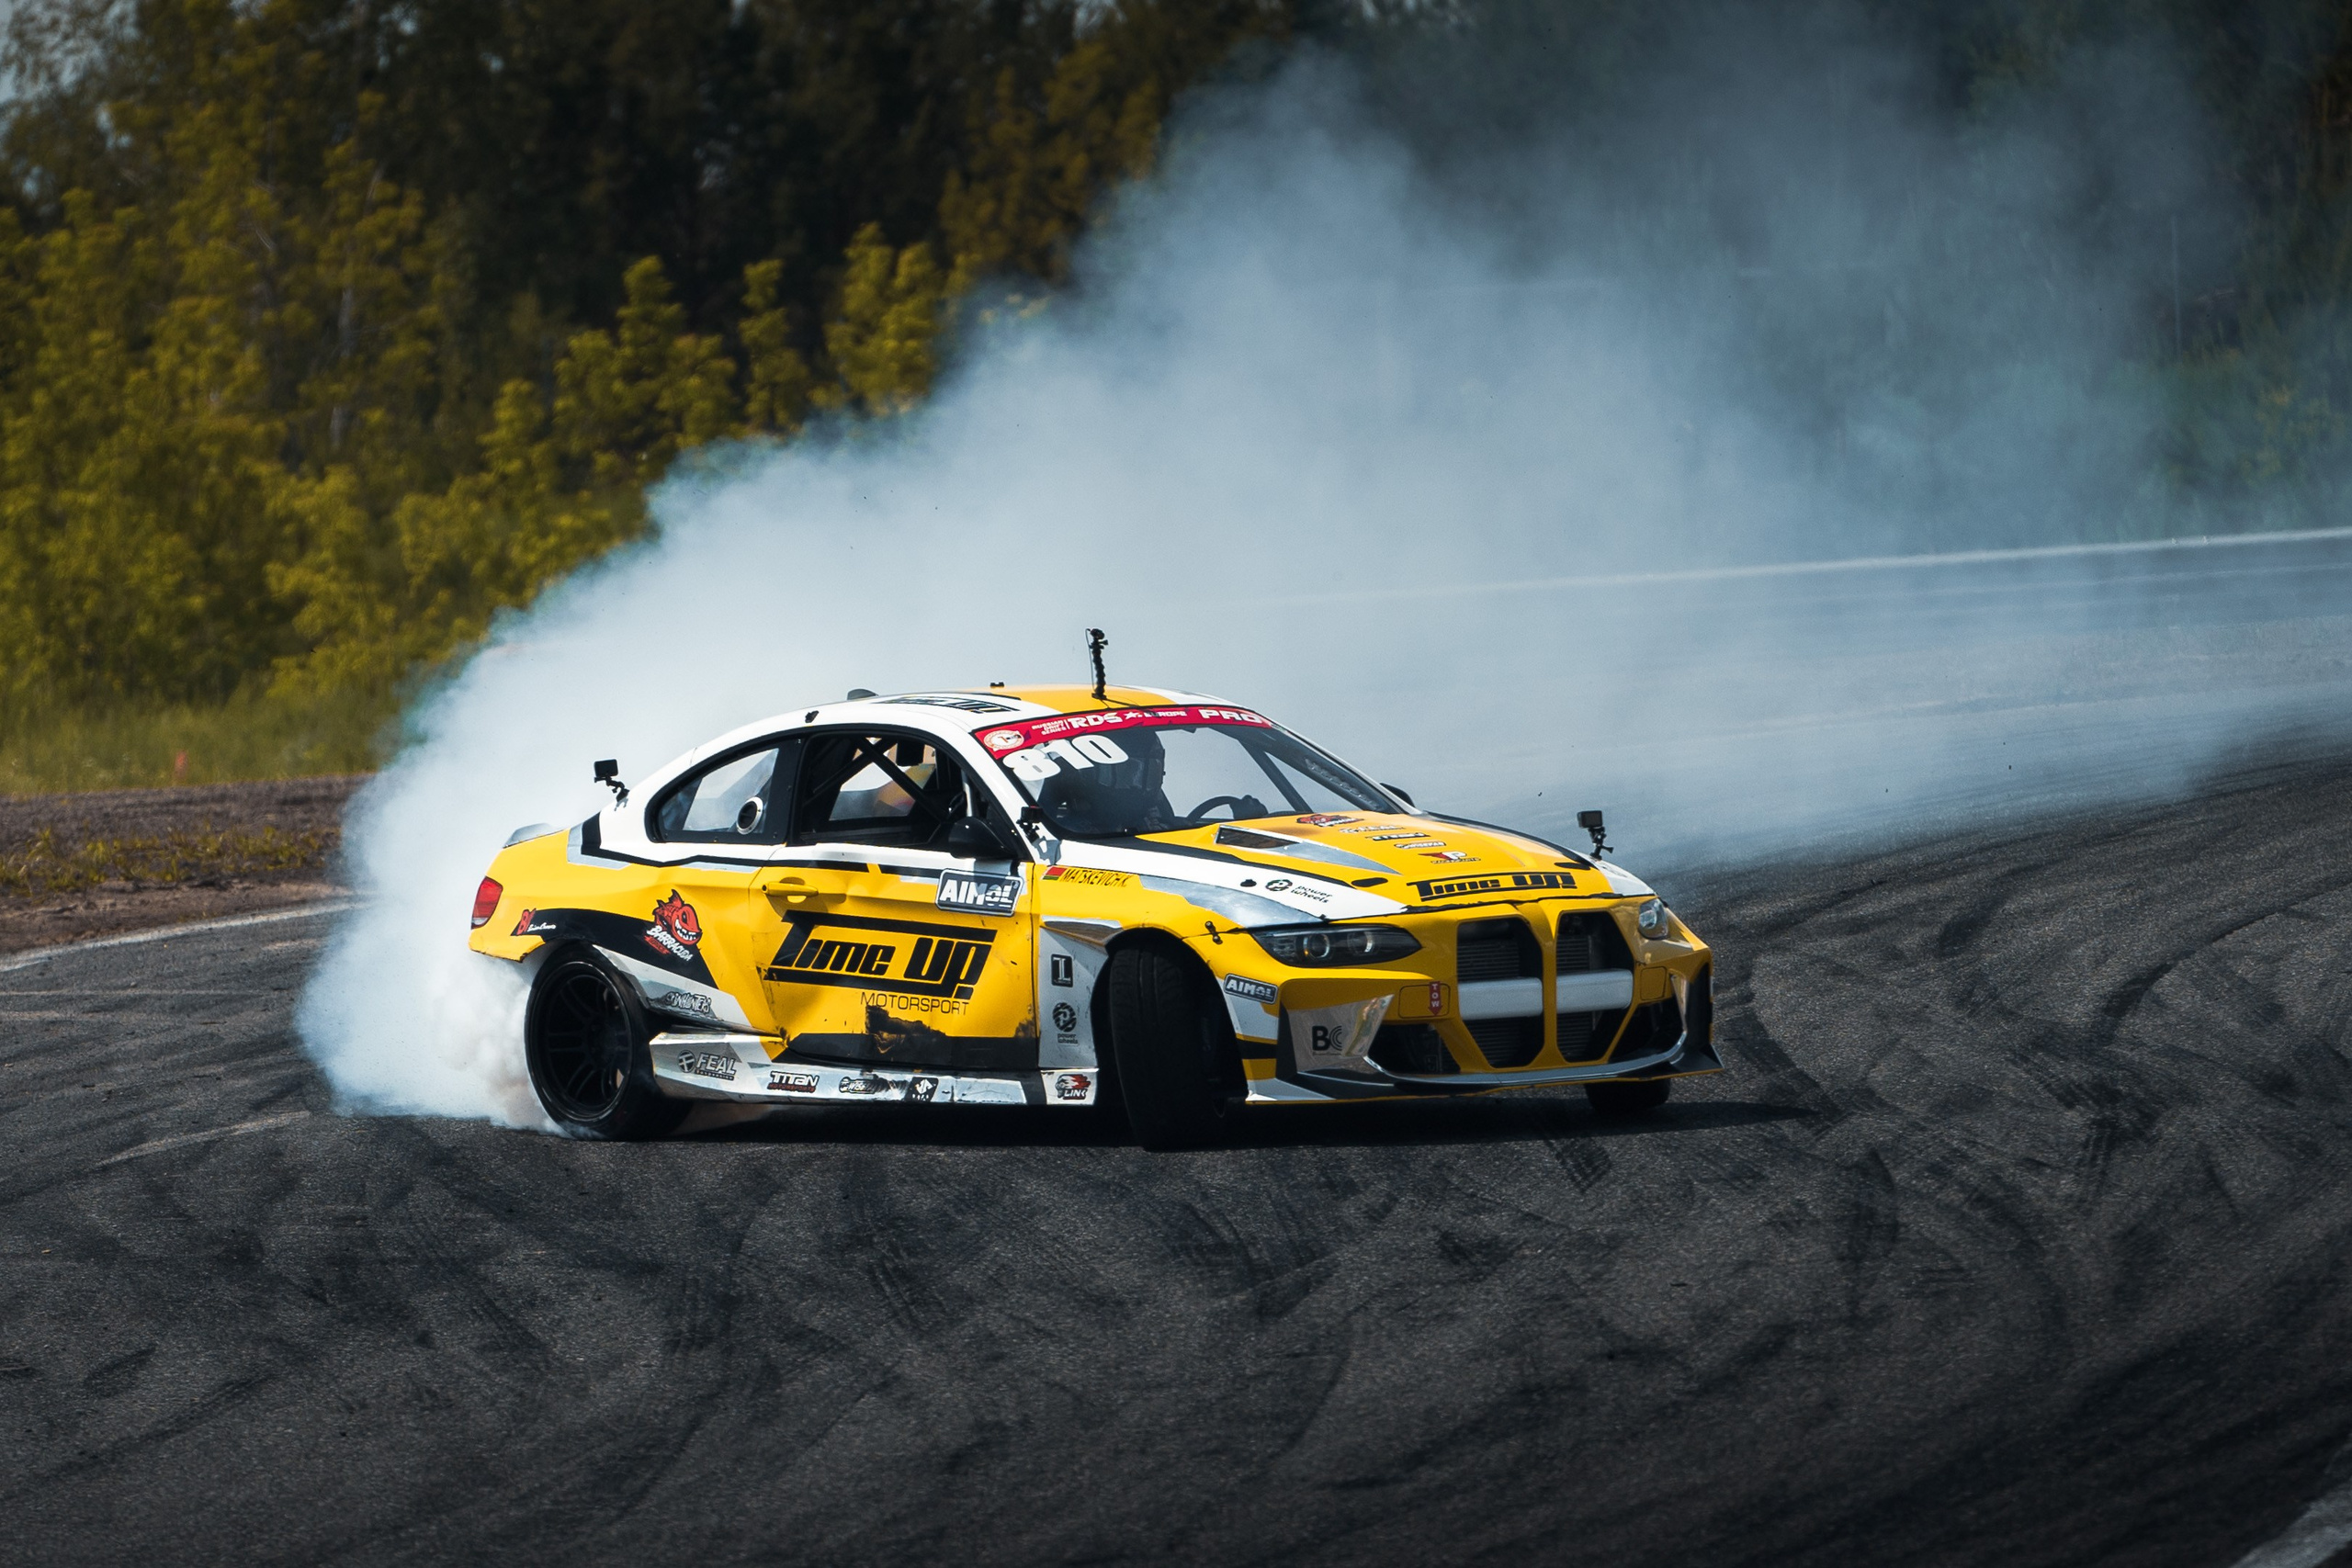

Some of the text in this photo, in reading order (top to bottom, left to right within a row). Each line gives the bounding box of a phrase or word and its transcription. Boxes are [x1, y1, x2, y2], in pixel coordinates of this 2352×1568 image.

[1069, 712, 1123, 729] RDS
[1198, 708, 1262, 724] PRO
[1002, 734, 1129, 782] 810
[1059, 868, 1122, 887] MATSKEVICH
[939, 879, 1013, 908] AIMOL
[646, 925, 694, 962] BARRACUDA
[1227, 978, 1273, 999] AIMOL
[1430, 984, 1440, 1008] TOW
[860, 991, 969, 1016] MOTORSPORT
[696, 1054, 738, 1076] FEAL
